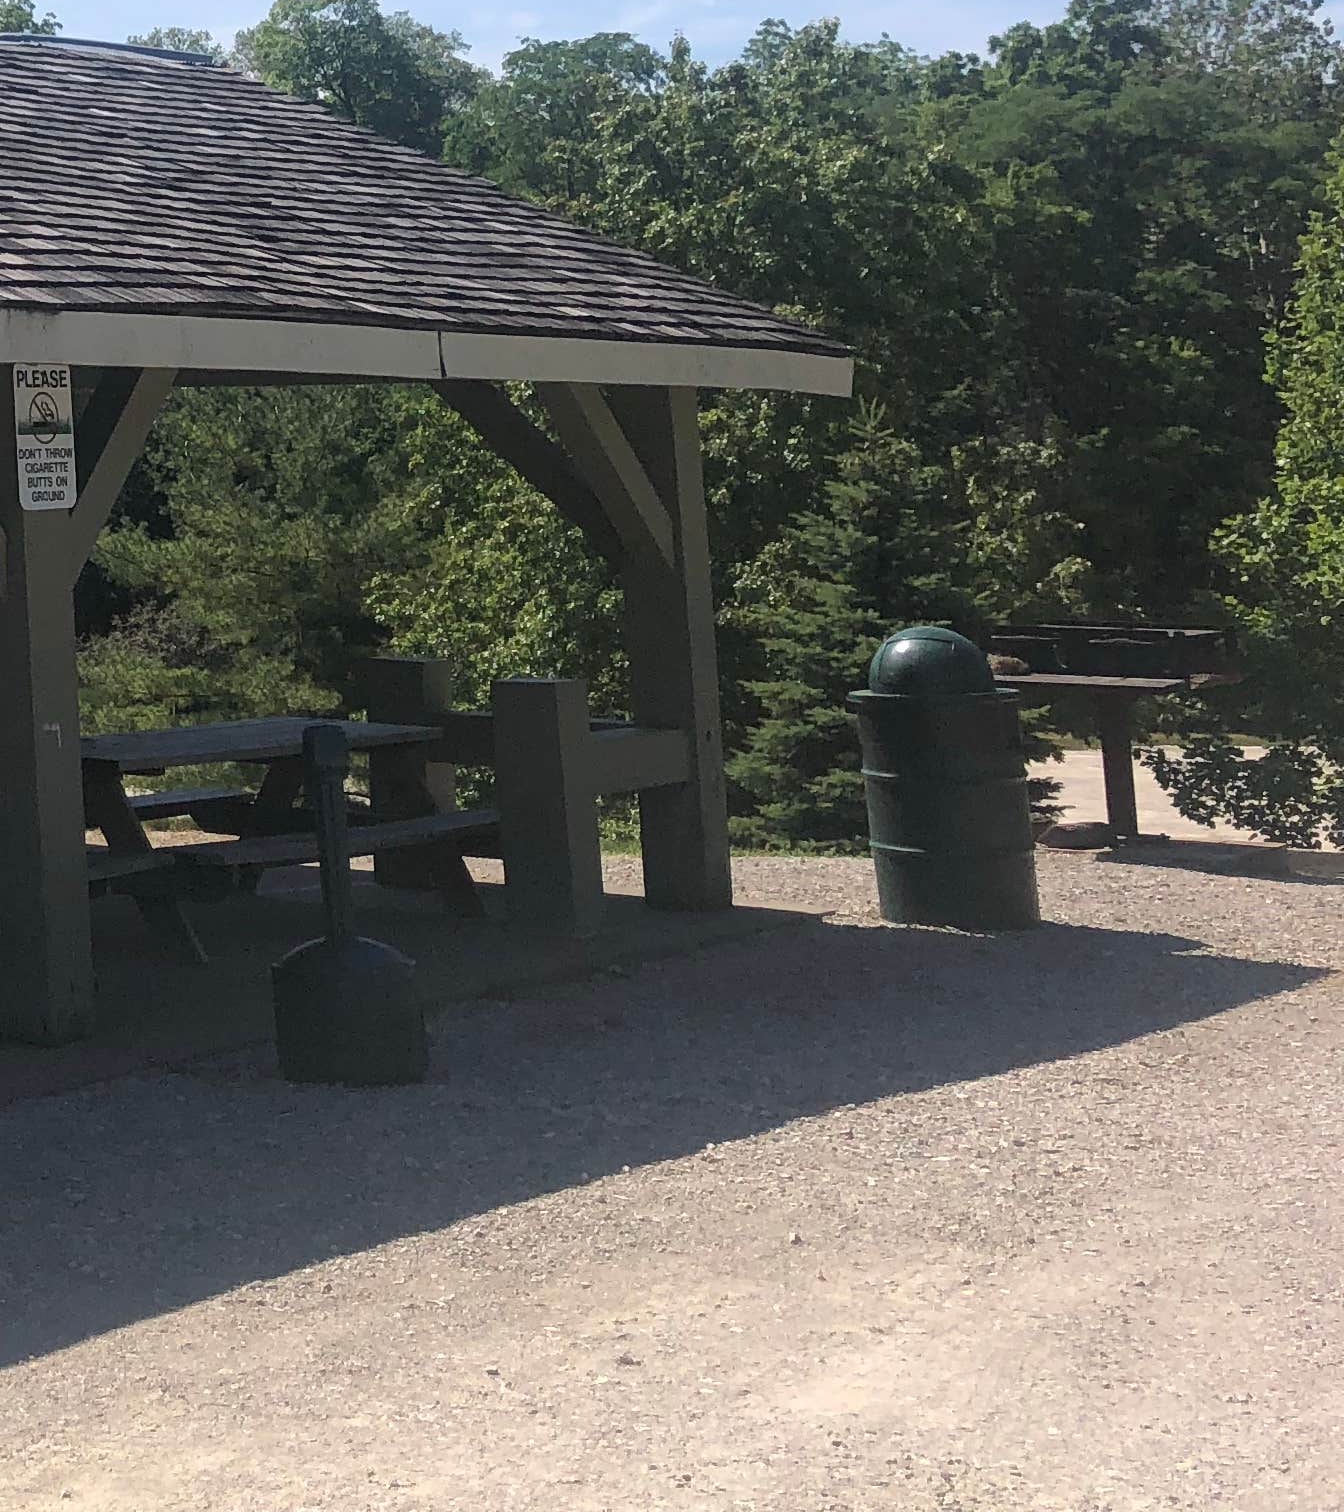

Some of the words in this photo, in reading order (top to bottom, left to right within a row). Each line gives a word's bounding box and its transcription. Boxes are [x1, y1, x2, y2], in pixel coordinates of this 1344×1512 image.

[16, 369, 68, 388] PLEASE
[18, 448, 42, 460] DON'T
[44, 447, 73, 459] THROW
[24, 462, 69, 474] CIGARETTE
[27, 476, 53, 488] BUTTS
[55, 475, 68, 487] ON
[31, 490, 65, 502] GROUND
